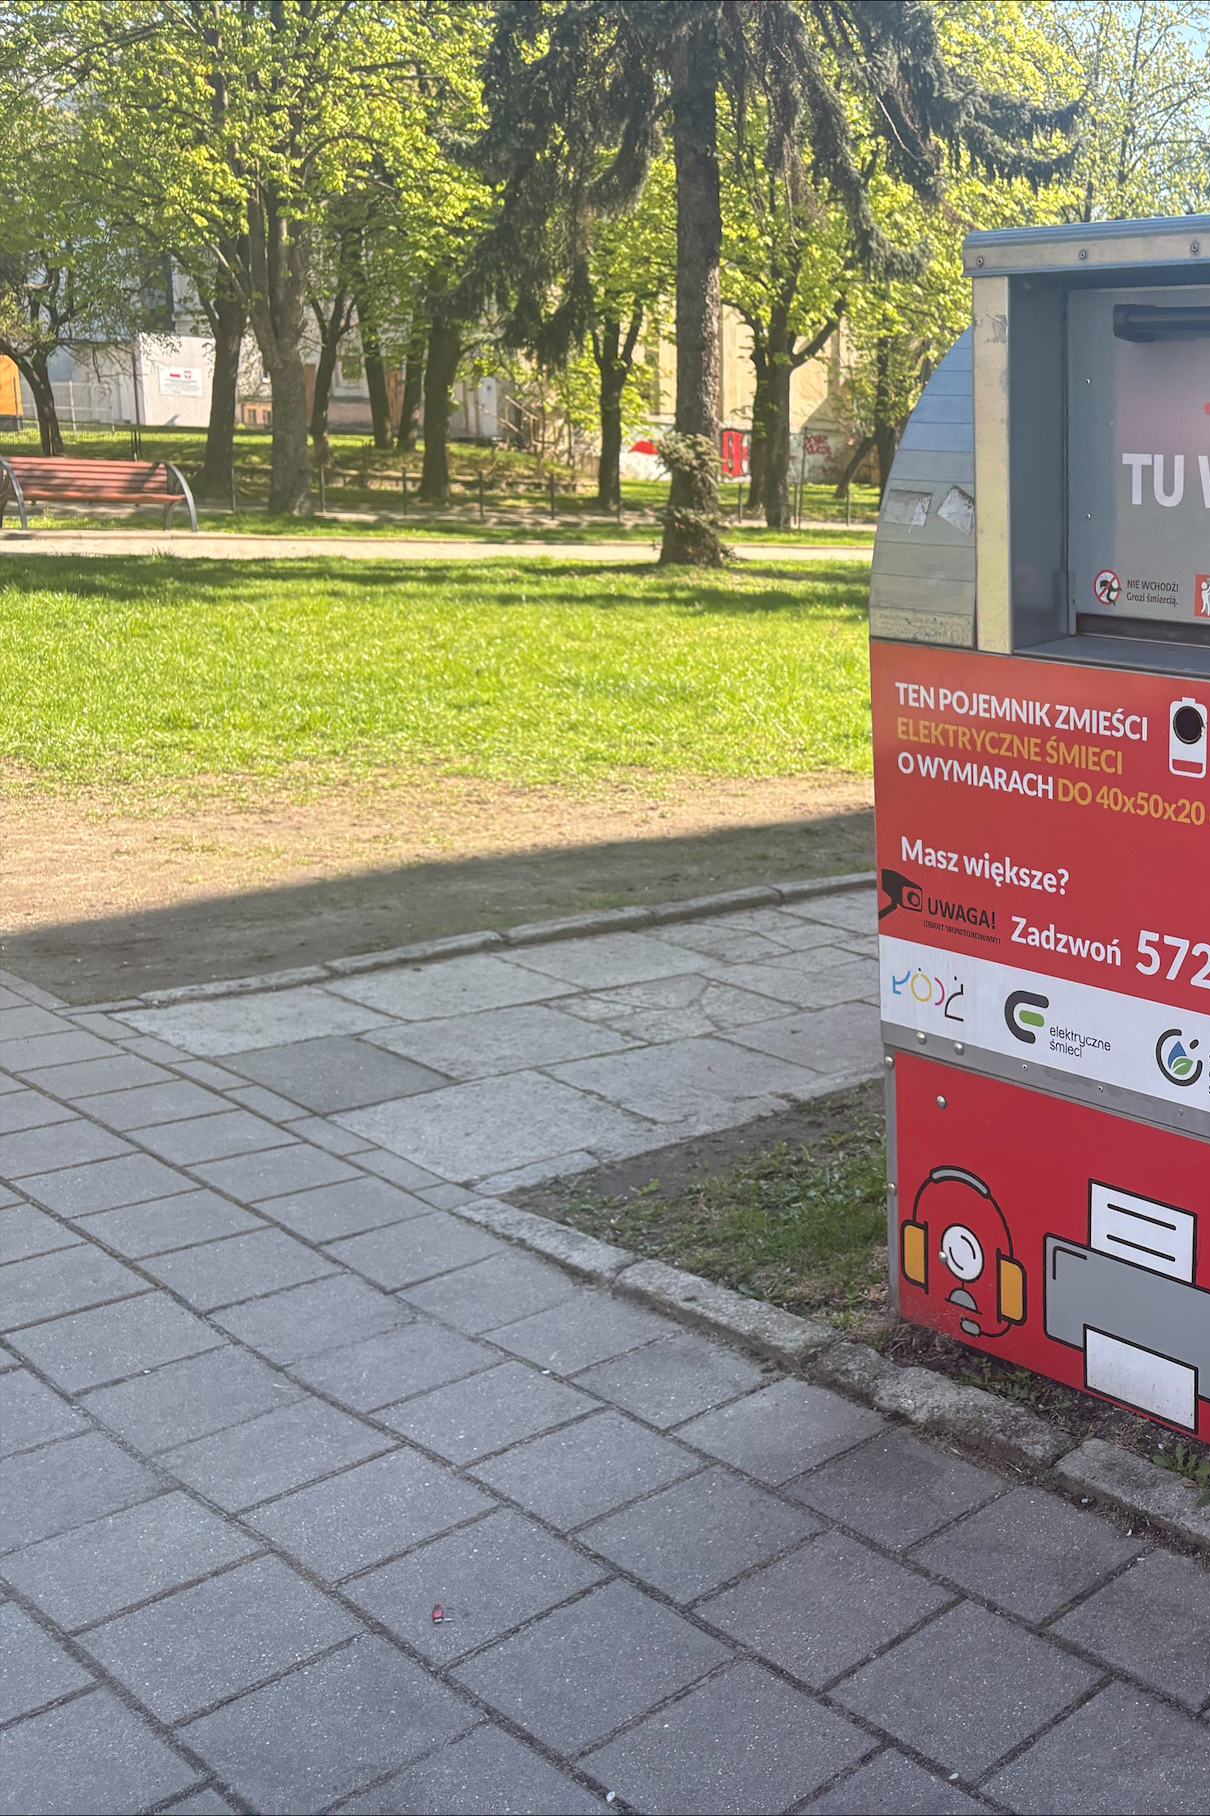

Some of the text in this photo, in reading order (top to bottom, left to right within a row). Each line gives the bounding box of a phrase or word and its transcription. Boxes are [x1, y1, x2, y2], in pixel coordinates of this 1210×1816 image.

[1122, 453, 1184, 507] TU
[1126, 592, 1145, 602] Grozi
[1127, 580, 1179, 592] NIE WCHODŹ!
[895, 682, 1147, 742] TEN POJEMNIK ZMIEŚCI
[897, 717, 1122, 775] ELEKTRYCZNE ŚMIECI
[897, 752, 914, 775] O
[917, 756, 1053, 800] WYMIARACH
[1058, 779, 1092, 805] DO
[1096, 785, 1206, 826] 40x50x20
[901, 836, 1069, 895] Masz większe?
[927, 897, 996, 930] UWAGA!
[1011, 916, 1121, 966] Zadzwoń
[1049, 1025, 1112, 1052] elektryczne
[1049, 1039, 1083, 1059] śmieci
